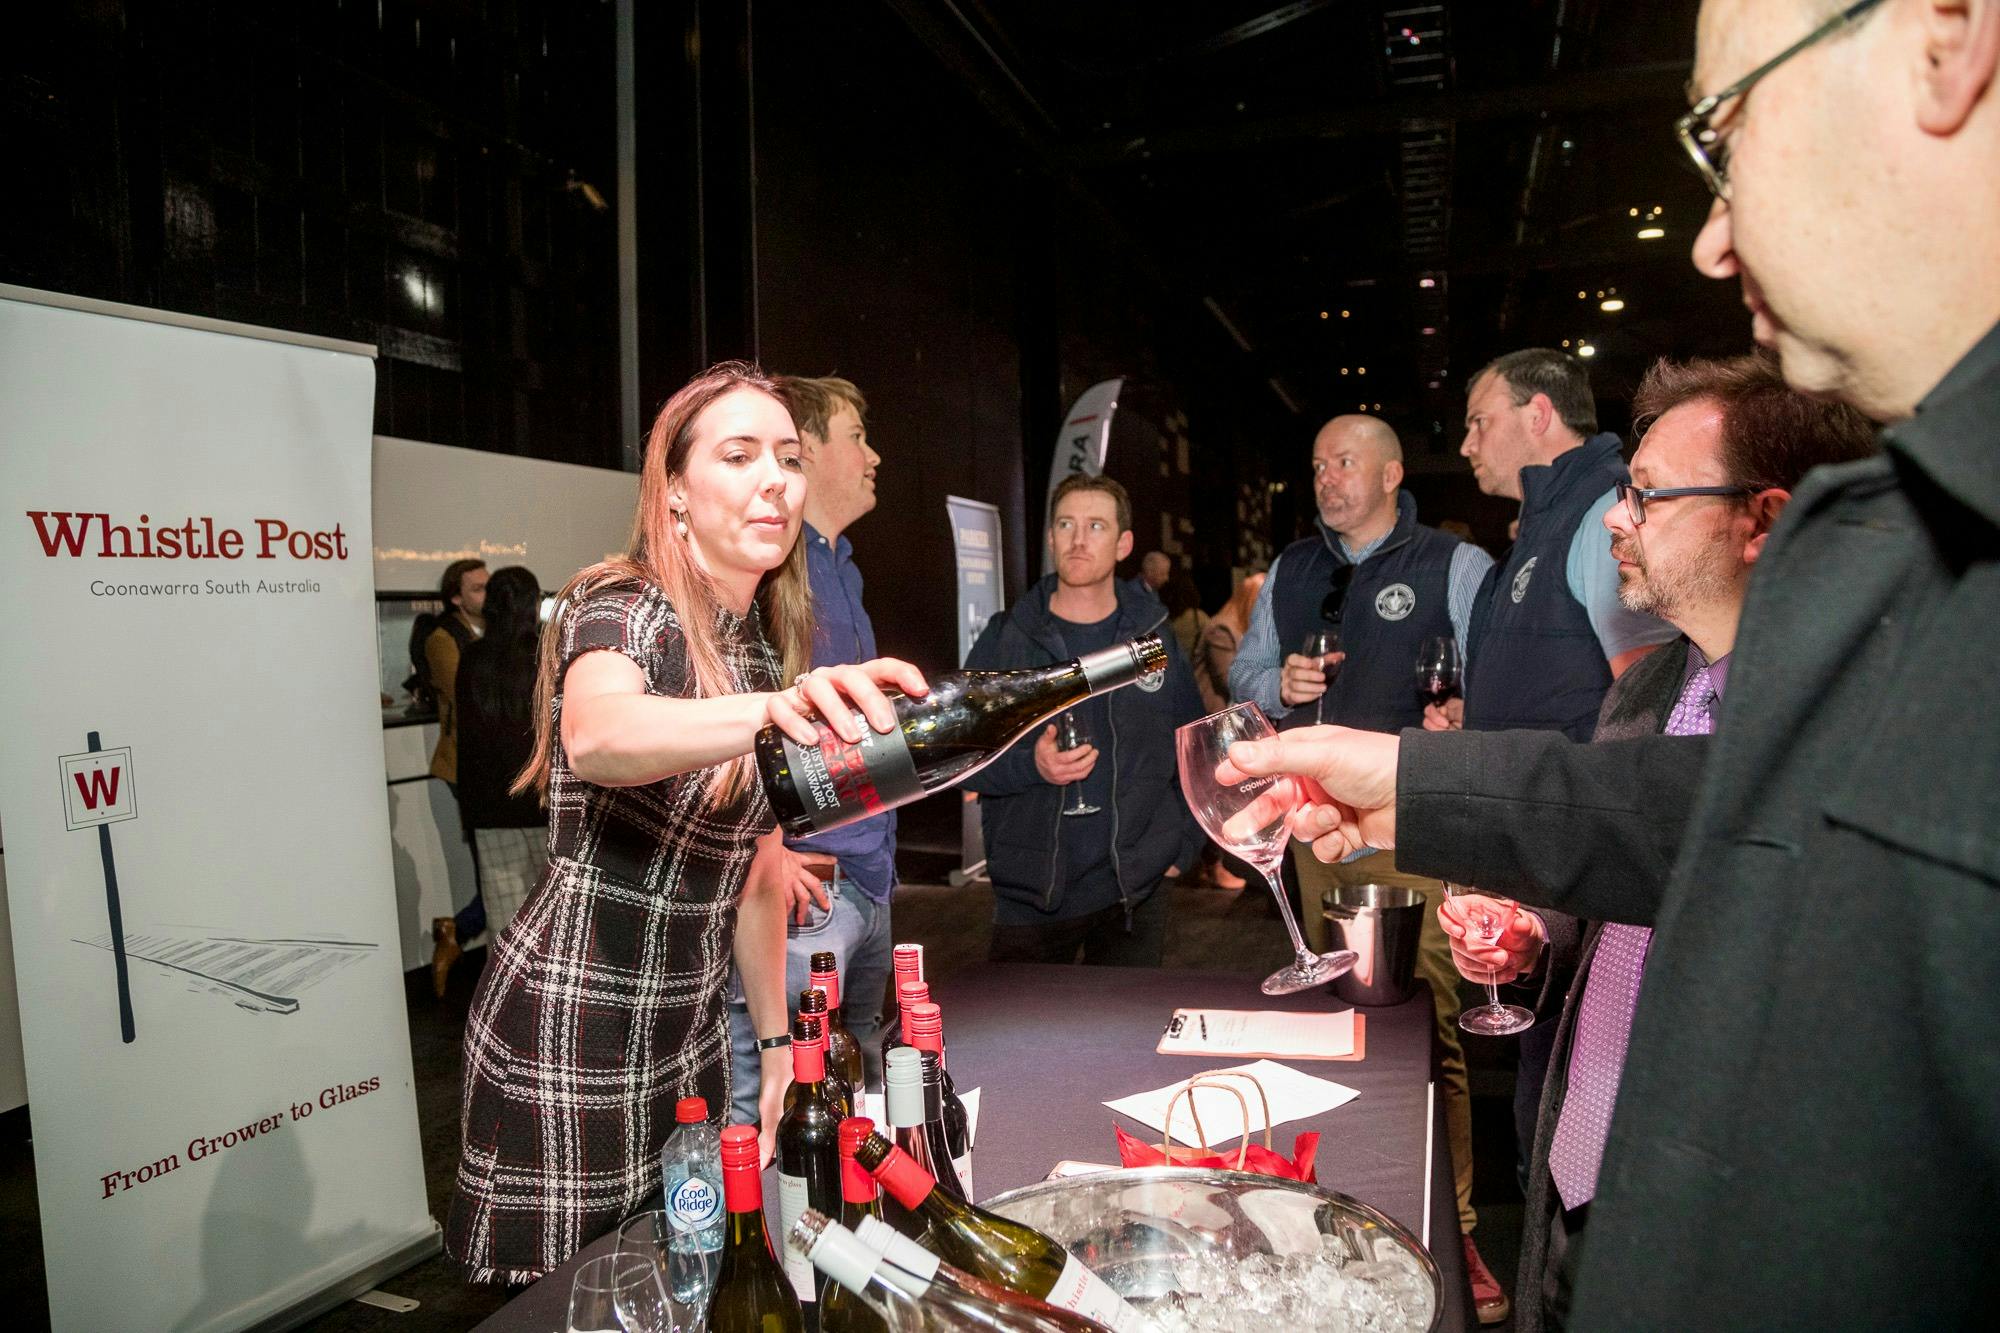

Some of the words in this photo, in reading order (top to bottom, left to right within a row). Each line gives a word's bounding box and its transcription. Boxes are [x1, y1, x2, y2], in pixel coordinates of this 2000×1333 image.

[1069, 434, 1090, 473] RA
[26, 511, 244, 559] Whistle
[254, 519, 348, 560] Post
[90, 580, 199, 596] Coonawarra
[205, 579, 250, 595] South
[256, 579, 321, 594] Australia
[74, 766, 120, 810] W
[798, 744, 828, 810] OONAWARRA
[810, 745, 830, 782] HISTLE
[822, 781, 840, 808] POST
[100, 1153, 181, 1199] From
[187, 1111, 283, 1162] Grower
[290, 1101, 313, 1121] to
[319, 1076, 380, 1109] Glass
[678, 1198, 713, 1212] Ridge
[681, 1186, 709, 1200] Cool
[1064, 1275, 1089, 1309] histle
